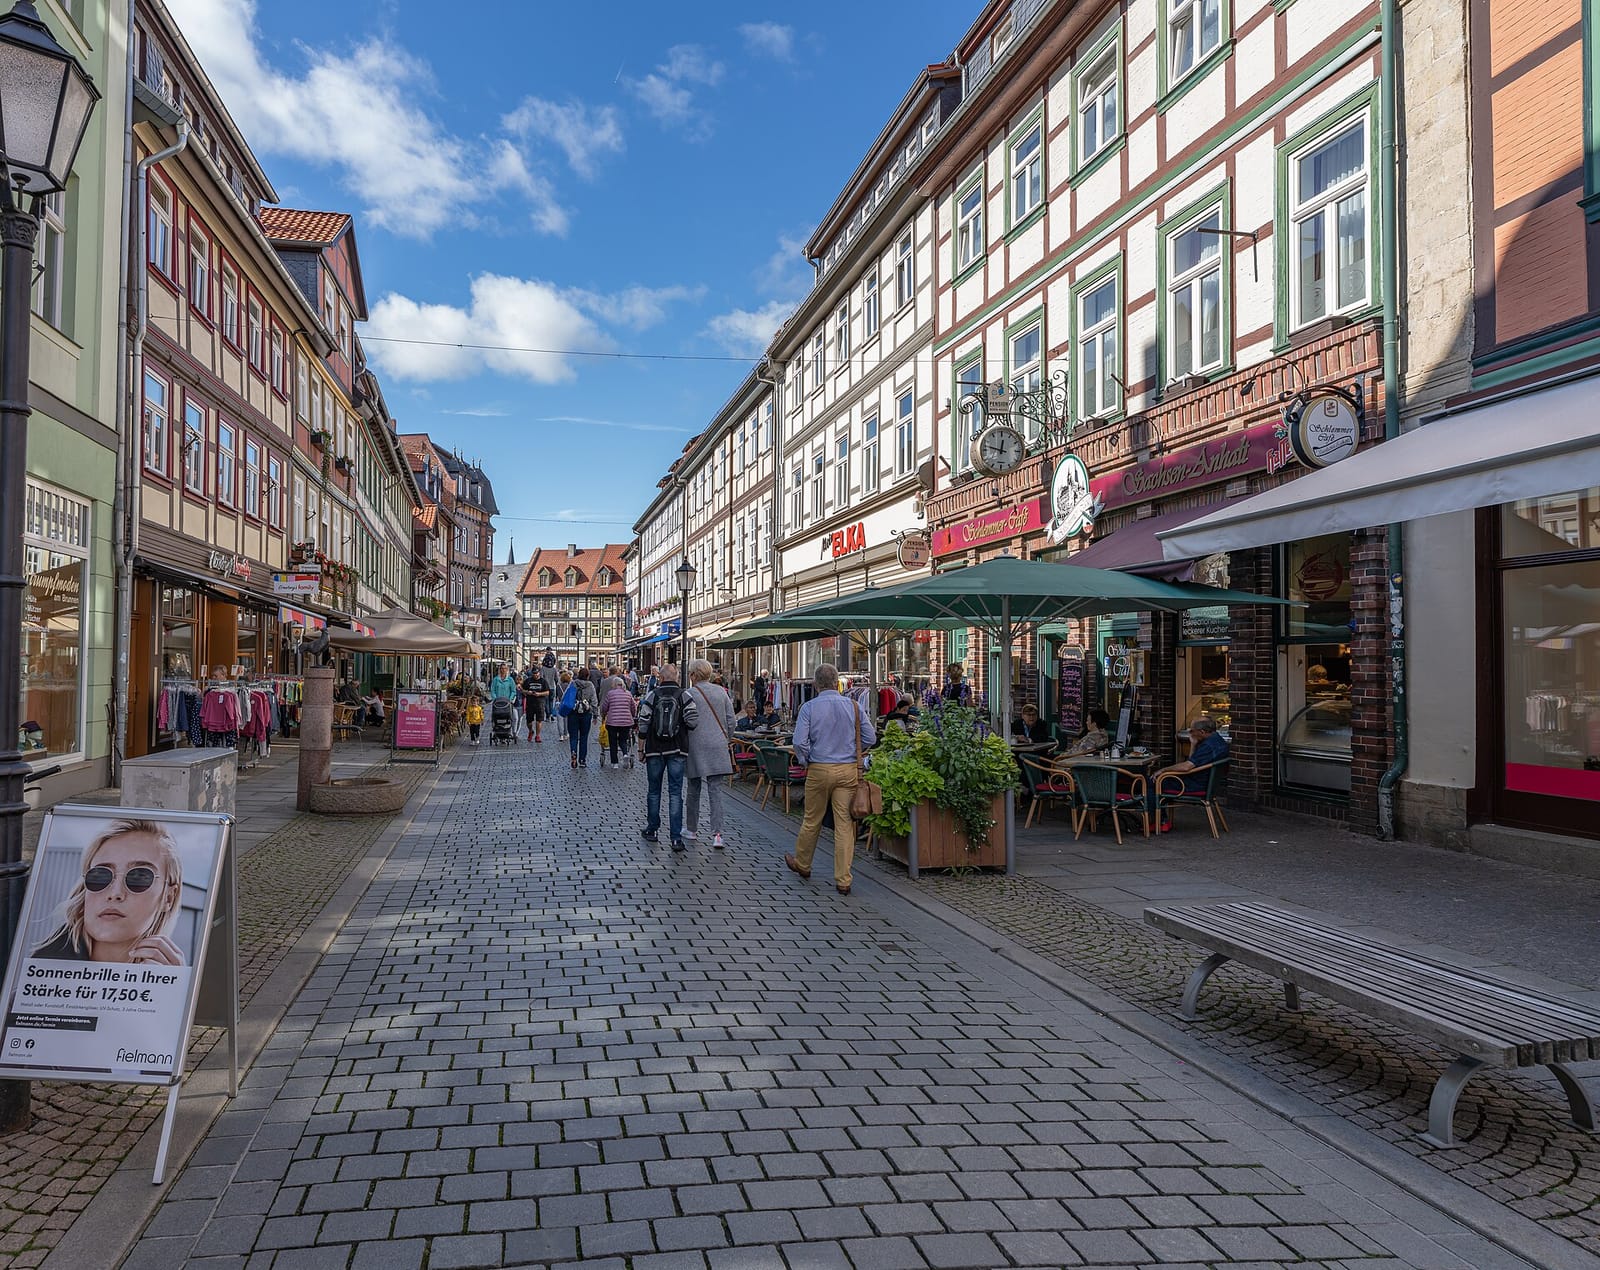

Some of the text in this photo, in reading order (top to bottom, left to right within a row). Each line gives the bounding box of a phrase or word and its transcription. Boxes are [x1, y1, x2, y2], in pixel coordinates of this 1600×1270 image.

[1309, 424, 1353, 434] Schlemmer
[1122, 435, 1250, 496] Sachsen-Anhalt
[832, 522, 867, 558] ELKA
[27, 965, 177, 985] Sonnenbrille in Ihrer
[22, 983, 71, 998] Stärke
[75, 985, 97, 999] für
